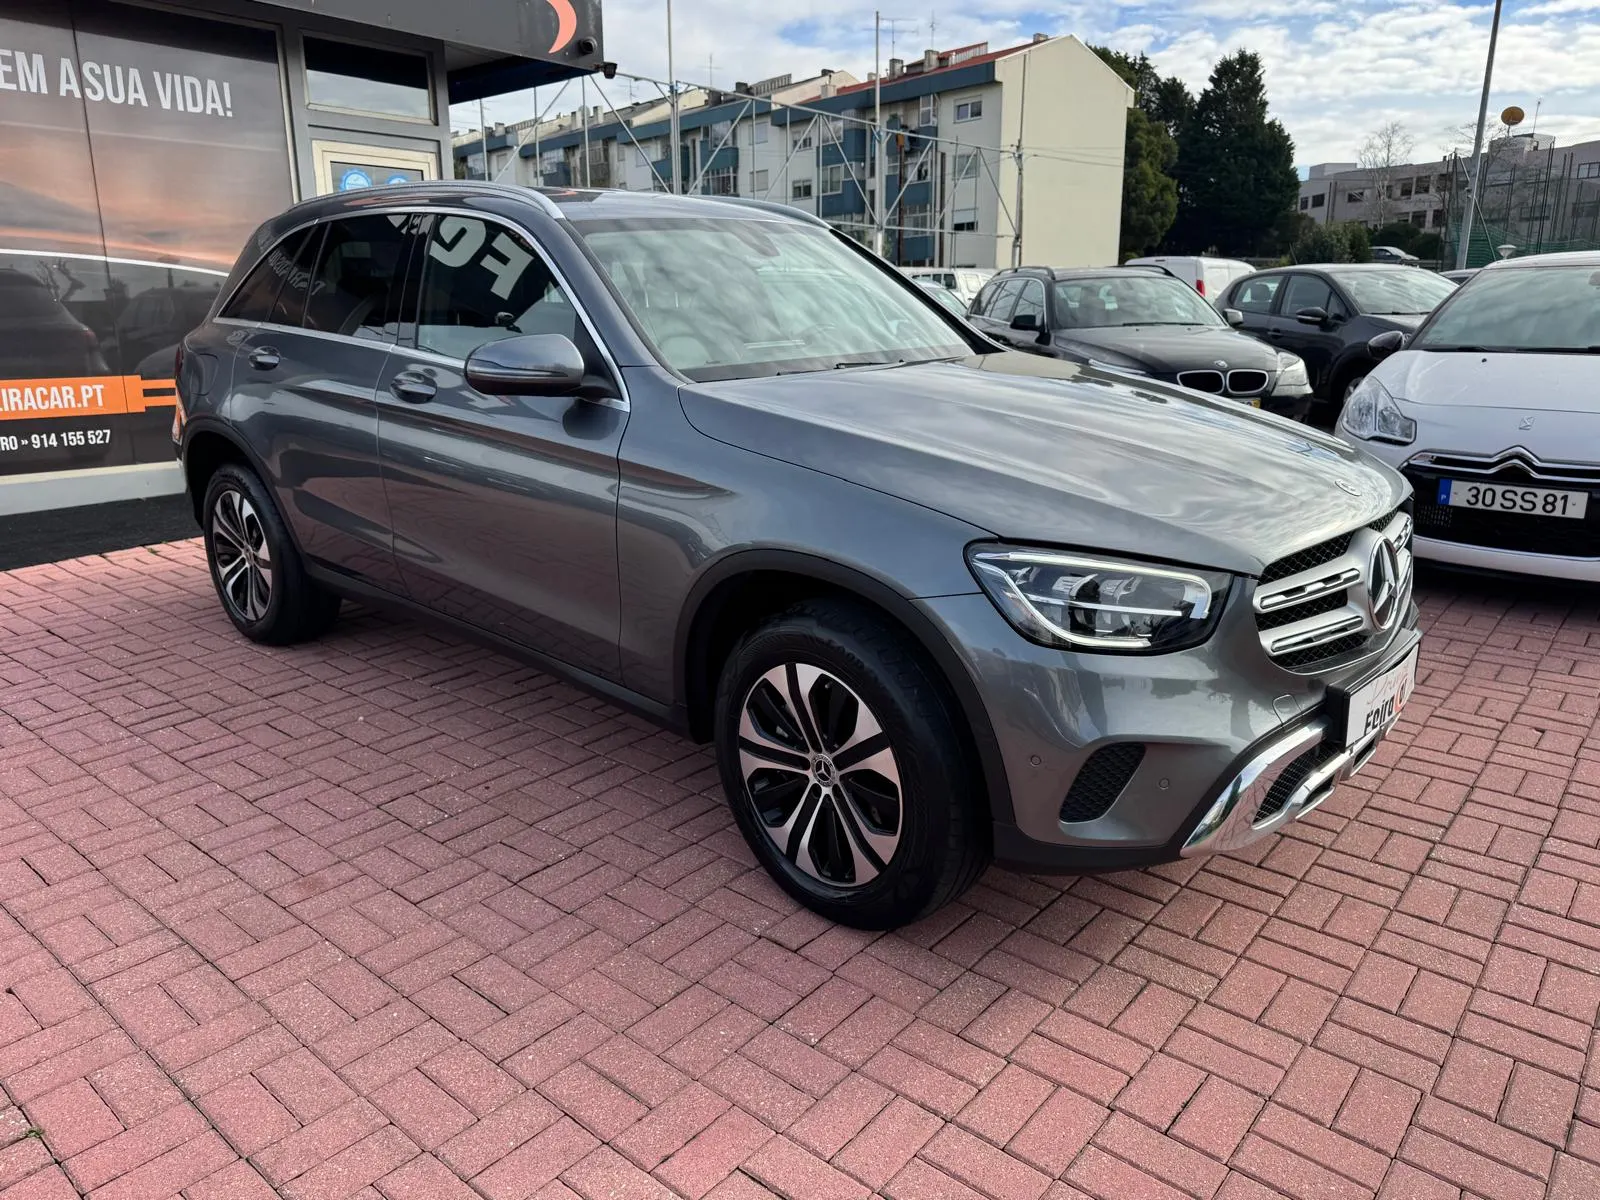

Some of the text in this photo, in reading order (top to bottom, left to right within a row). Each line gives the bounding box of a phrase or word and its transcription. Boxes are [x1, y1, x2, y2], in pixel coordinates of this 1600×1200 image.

[153, 71, 233, 118] VIDA!
[0, 384, 104, 412] IRACAR.PT
[31, 432, 58, 449] 914
[61, 430, 85, 446] 155
[87, 428, 111, 444] 527
